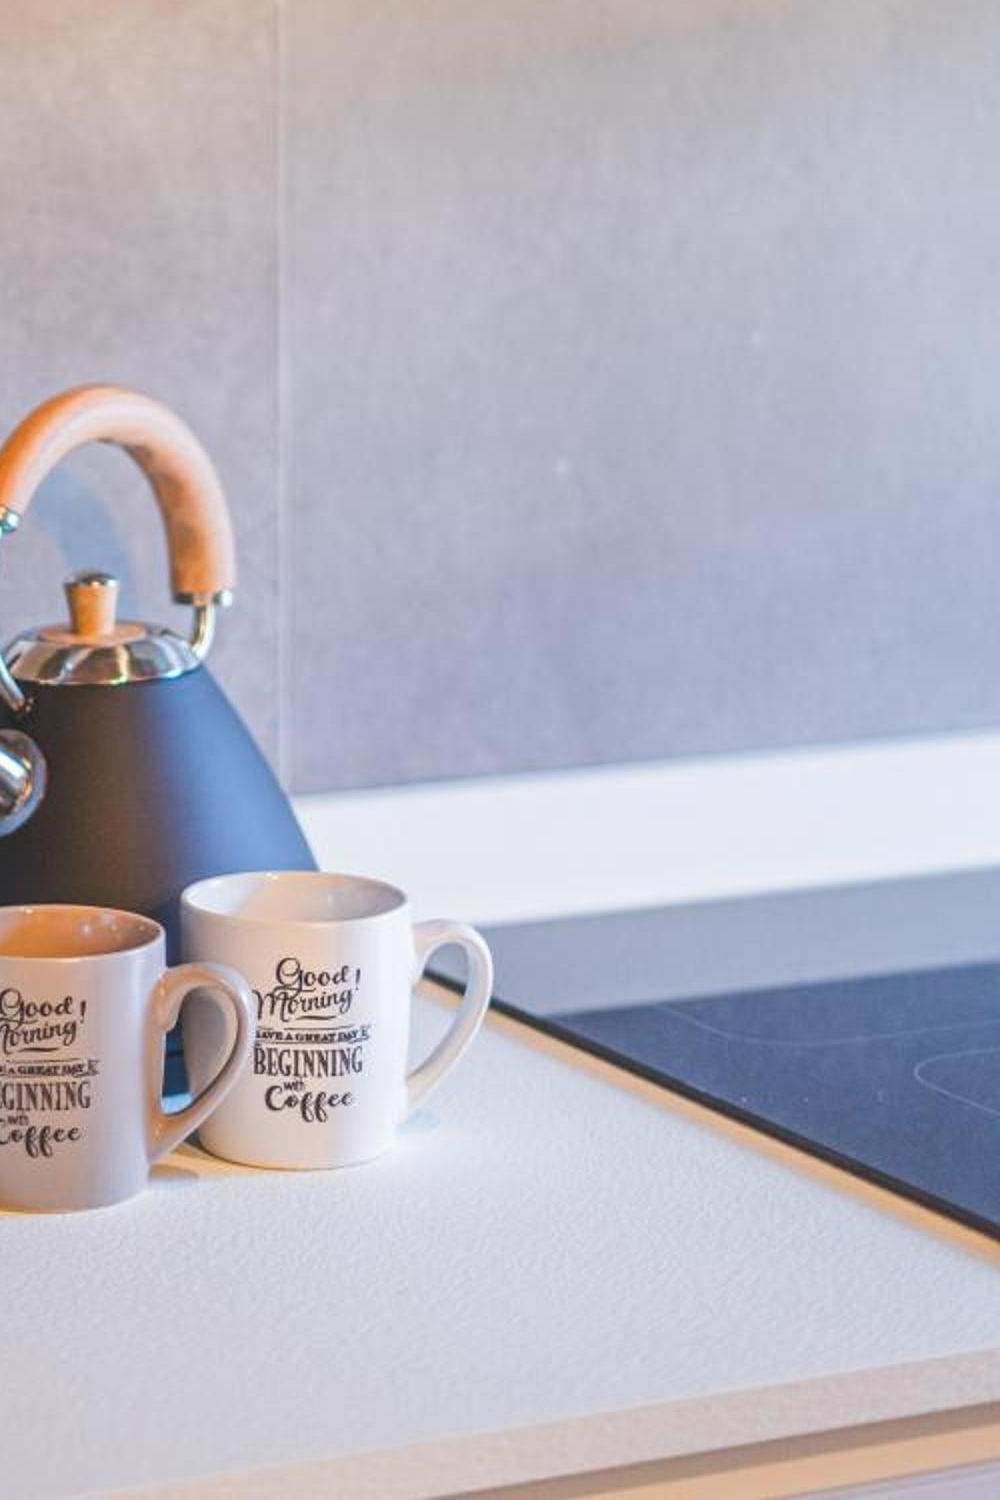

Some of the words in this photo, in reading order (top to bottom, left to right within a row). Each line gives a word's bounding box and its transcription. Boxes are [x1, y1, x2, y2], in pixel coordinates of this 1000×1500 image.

[295, 1032, 336, 1042] GREAT
[338, 1030, 358, 1042] DAY
[17, 1064, 60, 1075] GREAT
[253, 1046, 363, 1078] BEGINNING
[264, 1084, 353, 1123] Coffee
